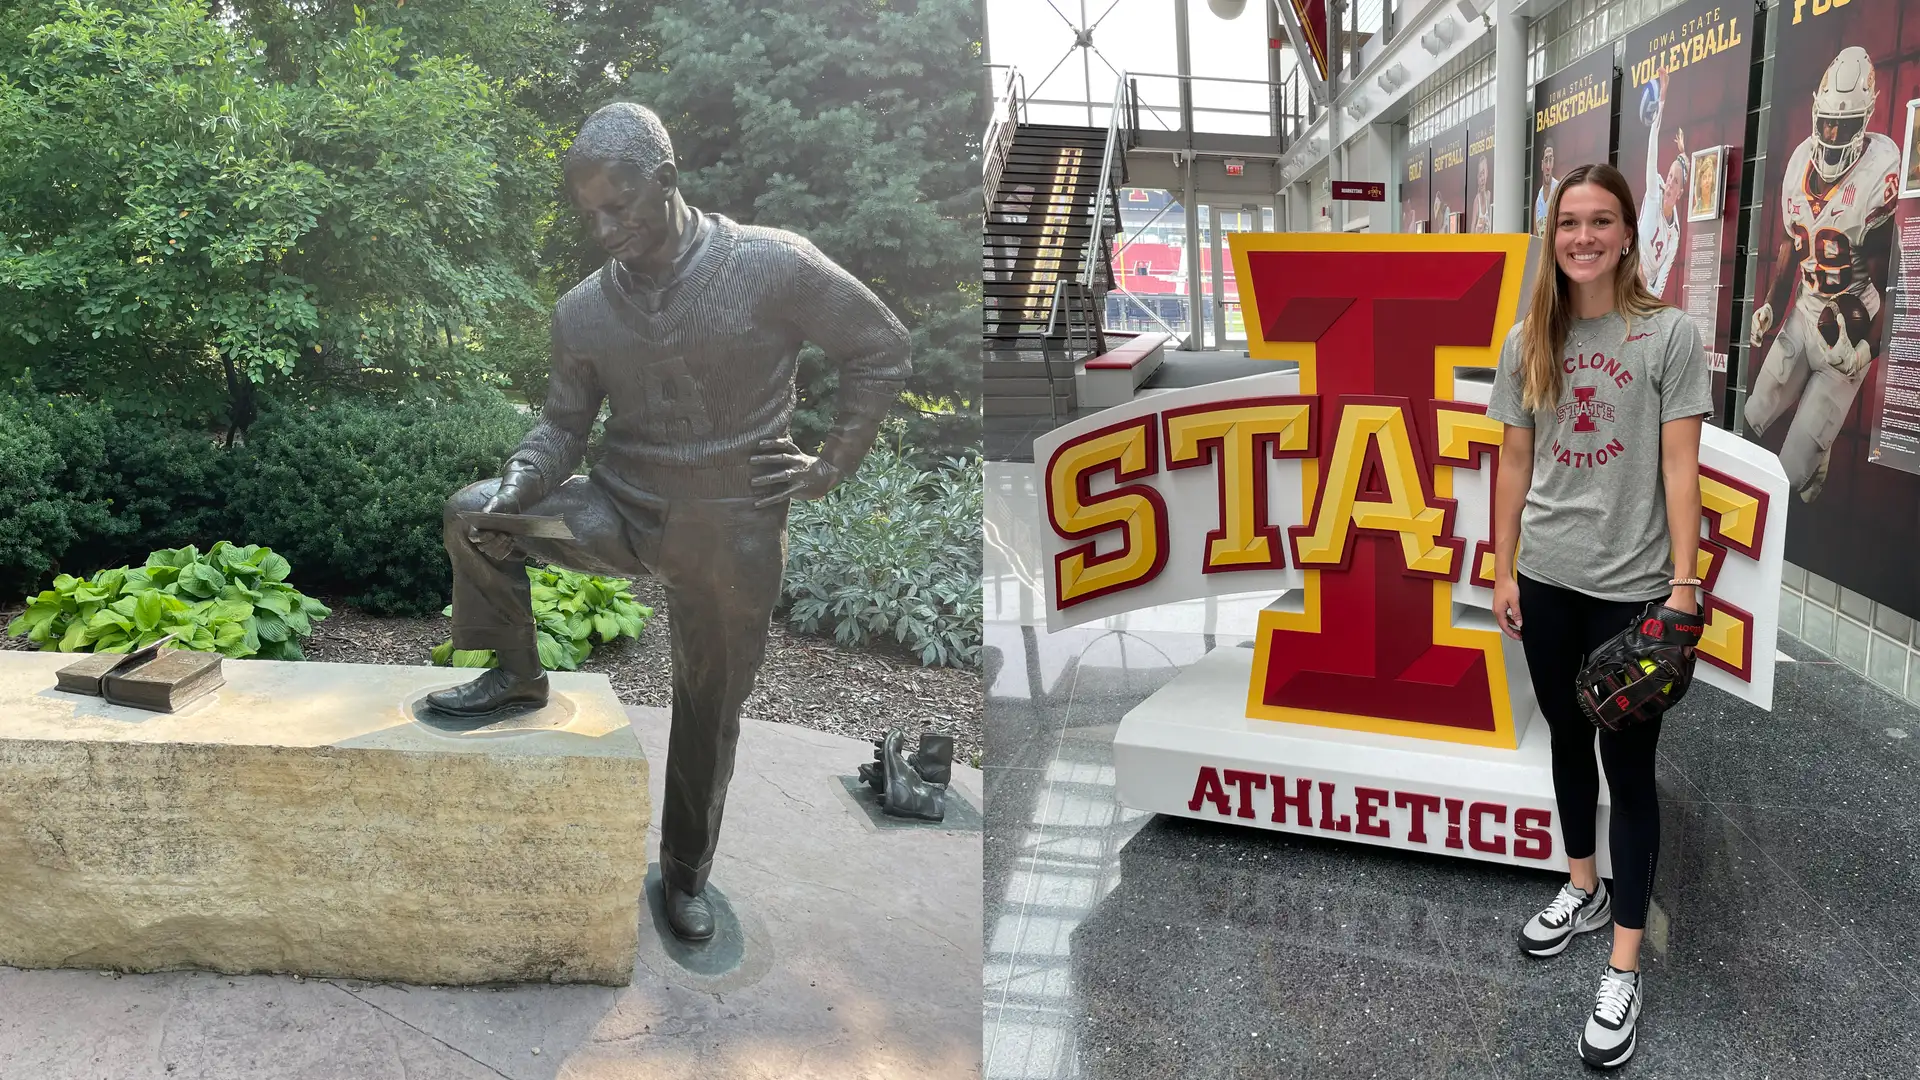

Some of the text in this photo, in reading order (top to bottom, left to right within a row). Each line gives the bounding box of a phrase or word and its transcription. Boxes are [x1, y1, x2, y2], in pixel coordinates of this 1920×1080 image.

[1649, 7, 1720, 52] IOWA STATE
[1631, 17, 1741, 88] VOLLEYBALL
[1549, 73, 1593, 104] IOWA STATE
[1536, 80, 1609, 132] BASKETBALL
[1408, 160, 1423, 182] GOLF
[1434, 148, 1464, 173] SOFTBALL
[1563, 351, 1633, 389] CLONE
[1556, 401, 1615, 425] STATE
[1551, 437, 1625, 469] NATION
[1674, 623, 1704, 637] ilson
[1188, 766, 1552, 860] ATHLETICS
